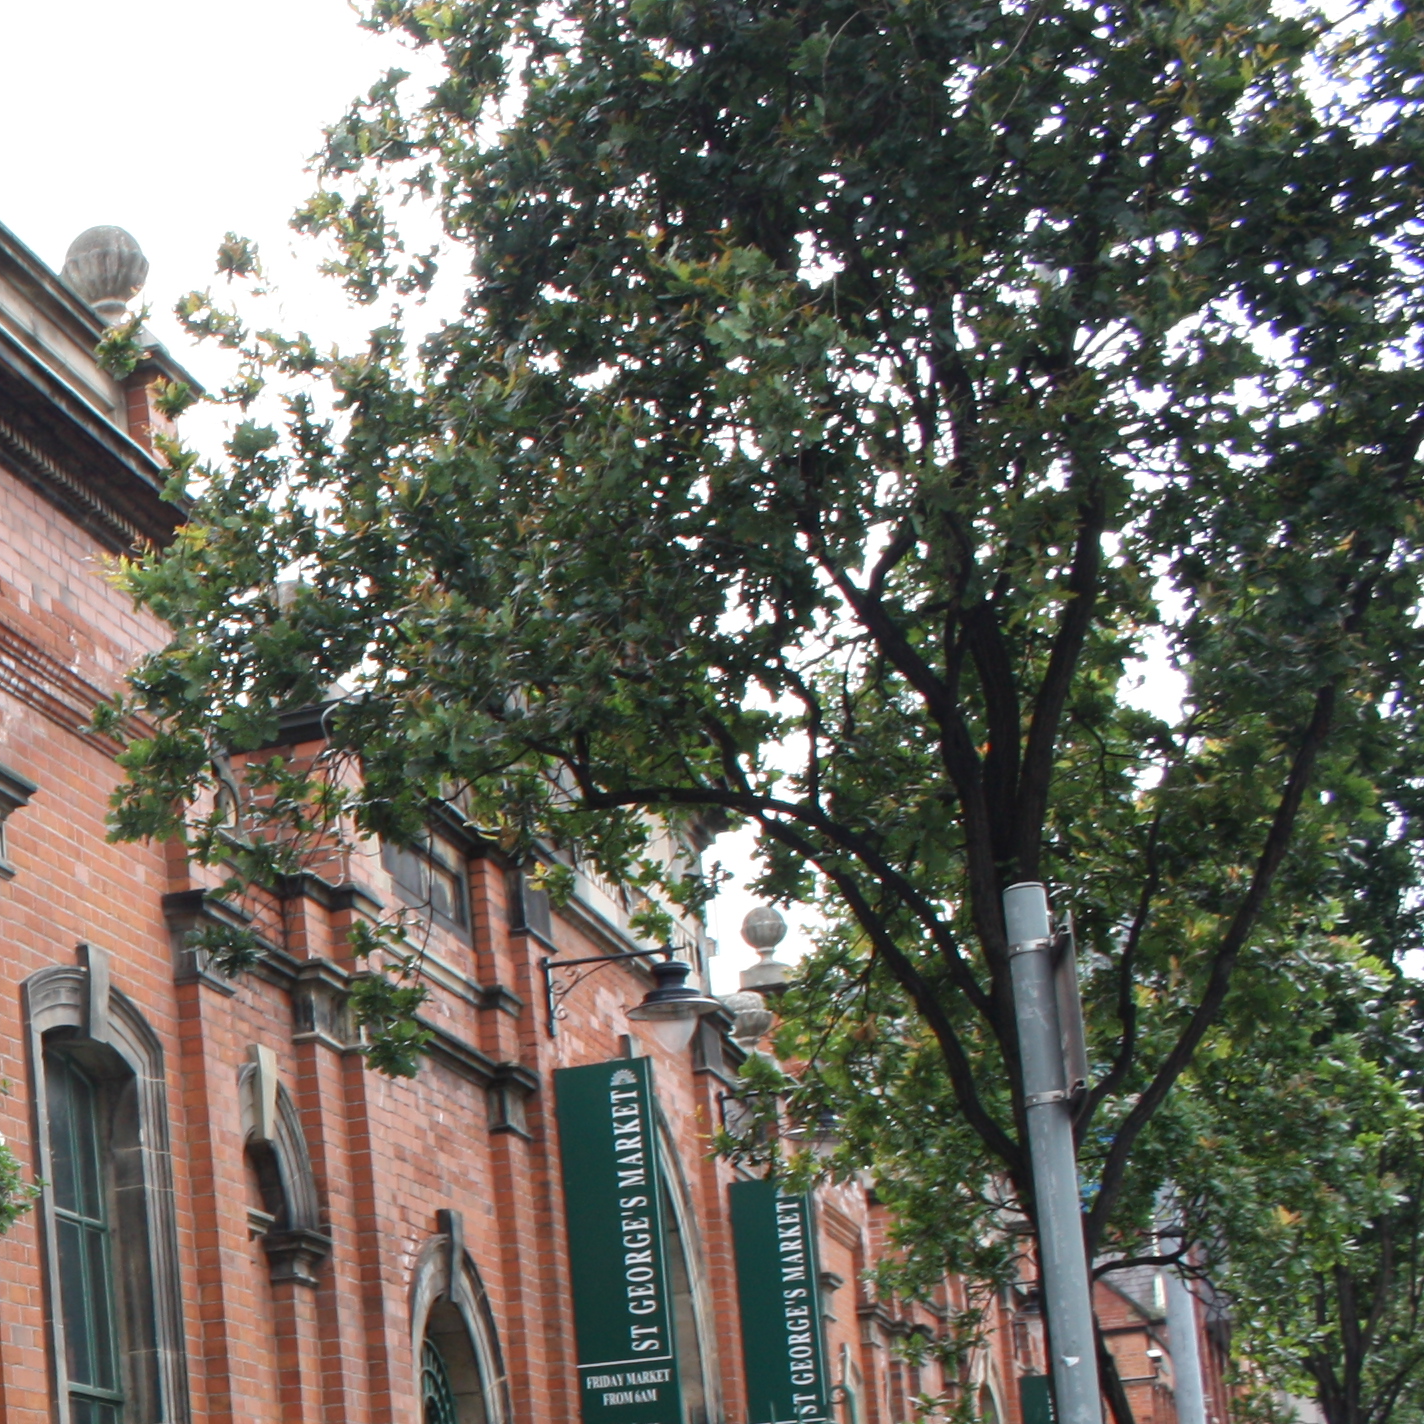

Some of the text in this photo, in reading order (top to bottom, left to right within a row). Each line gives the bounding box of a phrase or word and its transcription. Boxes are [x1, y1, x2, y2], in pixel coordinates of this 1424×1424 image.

[610, 1089, 660, 1351] ST GEORGE'S MARKET
[775, 1201, 806, 1282] MARKET
[783, 1288, 815, 1385] GEORGE'S
[586, 1369, 671, 1389] FRIDAY MARKET
[603, 1391, 634, 1406] FROM
